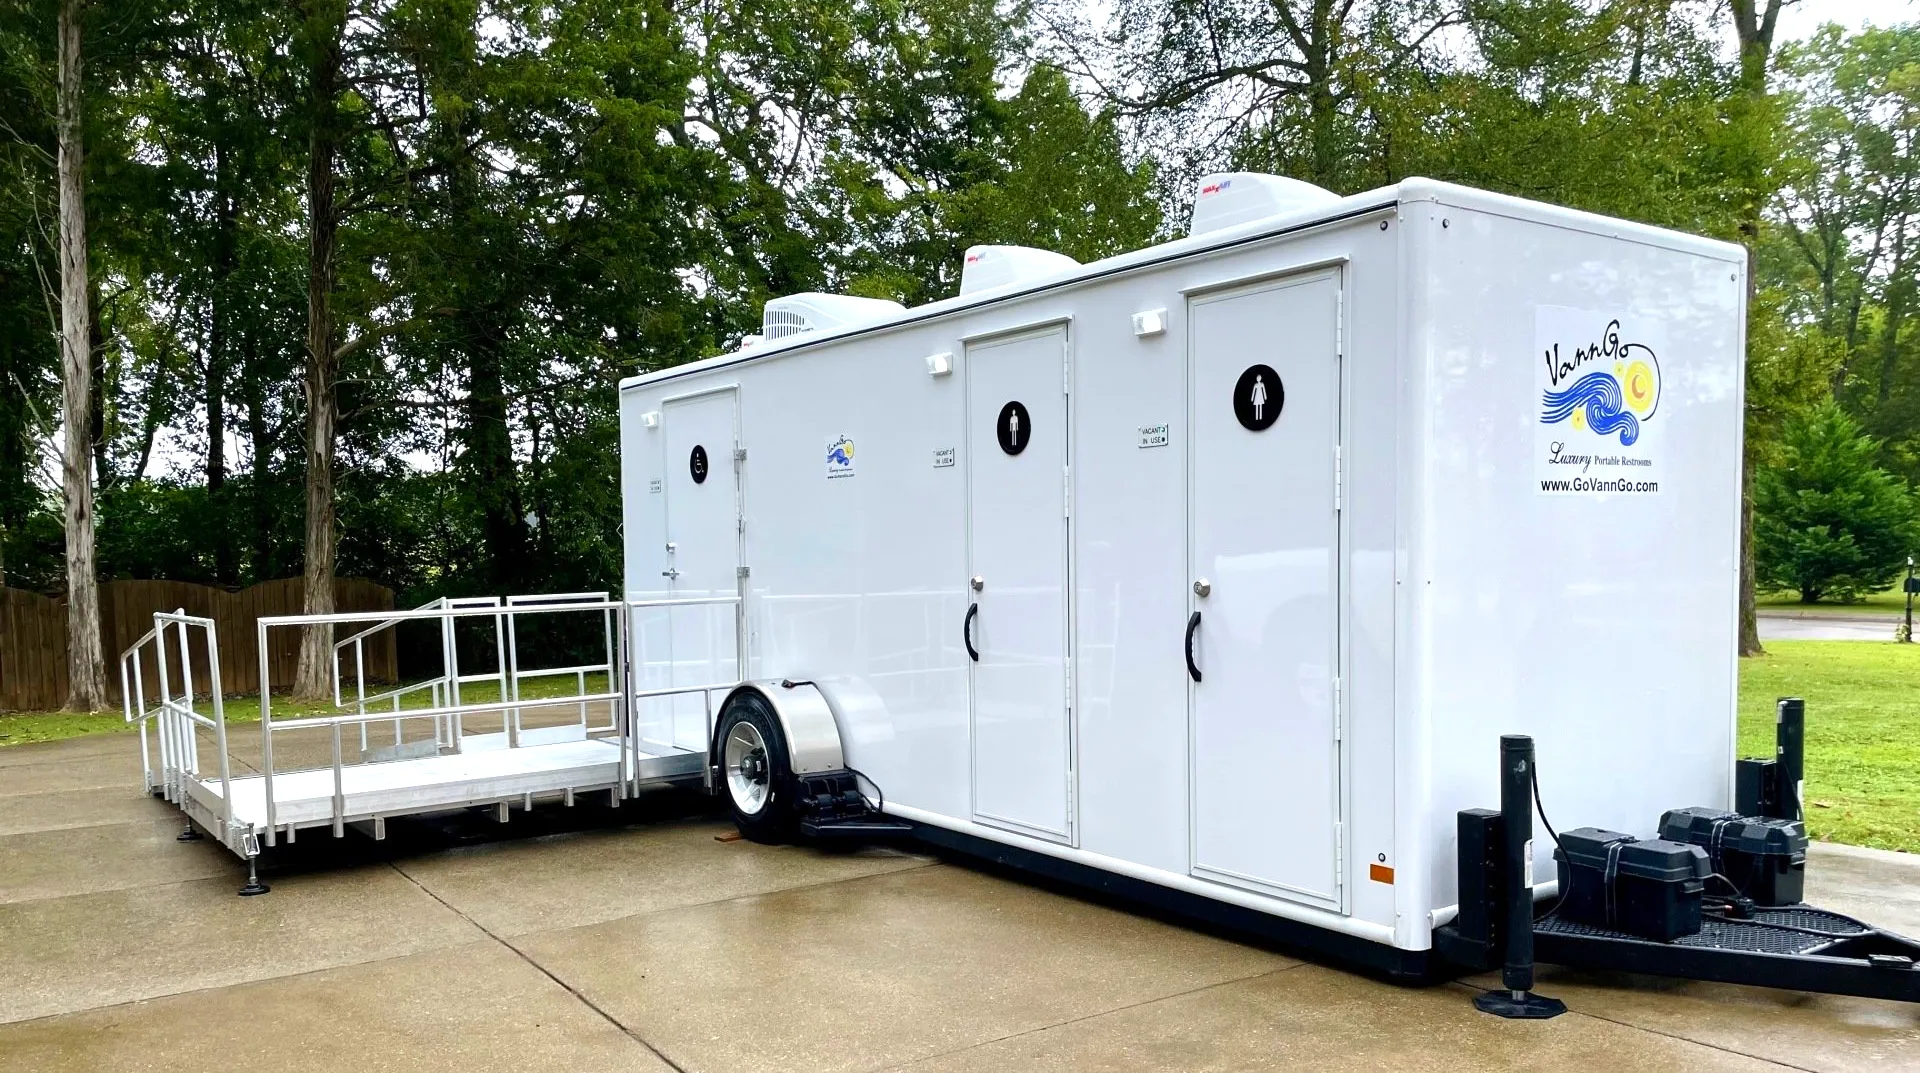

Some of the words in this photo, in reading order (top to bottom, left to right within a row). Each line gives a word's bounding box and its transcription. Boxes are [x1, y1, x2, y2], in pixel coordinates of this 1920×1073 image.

[1545, 319, 1645, 387] VannGo
[1549, 441, 1591, 473] Luxury
[1594, 455, 1620, 466] Portable
[1622, 456, 1652, 467] Restrooms
[1541, 477, 1658, 492] www.GoVannGo.com
